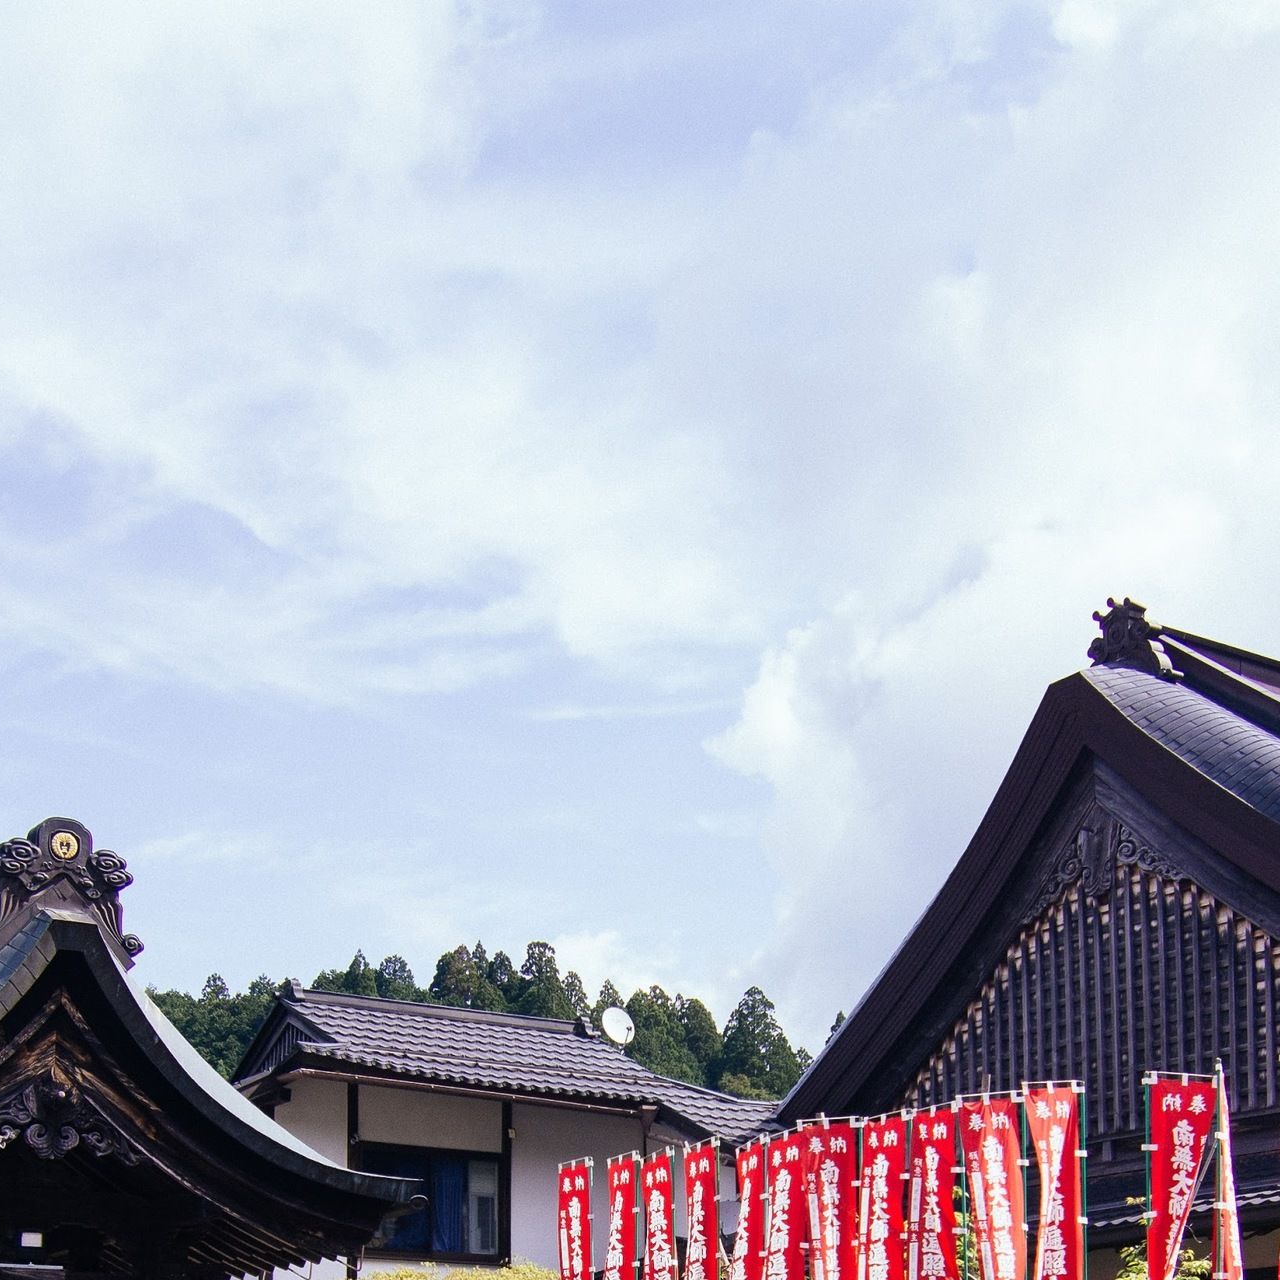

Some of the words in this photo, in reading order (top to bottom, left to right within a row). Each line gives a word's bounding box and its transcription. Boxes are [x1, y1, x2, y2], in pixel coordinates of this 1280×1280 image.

[1036, 1101, 1070, 1120] 奉納
[968, 1111, 1010, 1132] 奉納
[868, 1129, 898, 1149] 奉納
[919, 1122, 947, 1141] 奉納
[808, 1136, 847, 1154] 奉納
[772, 1145, 799, 1168] 奉納
